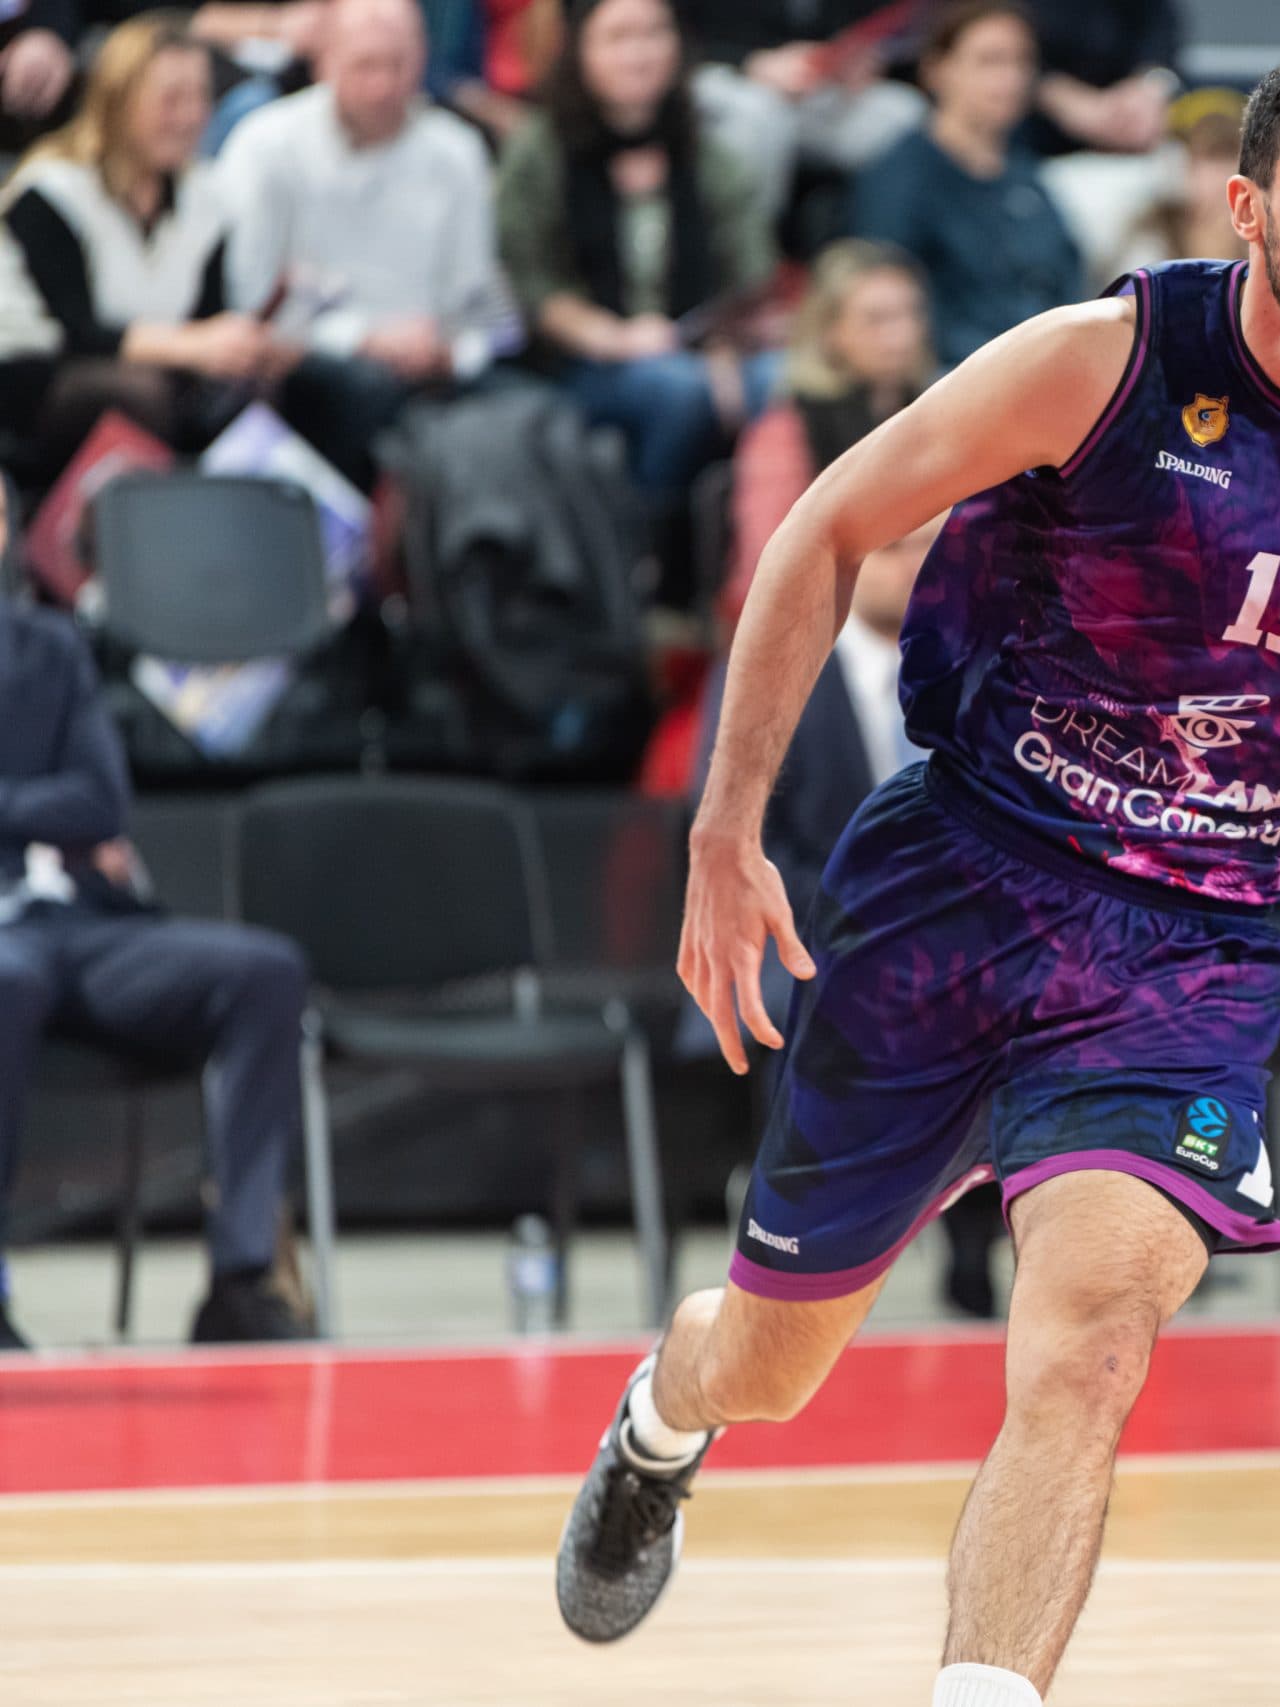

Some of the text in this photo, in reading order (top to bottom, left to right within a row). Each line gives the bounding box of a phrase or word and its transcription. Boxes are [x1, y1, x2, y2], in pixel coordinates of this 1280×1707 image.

[1155, 450, 1232, 489] SPALDING
[1176, 1145, 1219, 1170] EuroCup
[747, 1217, 799, 1255] SPALDING
